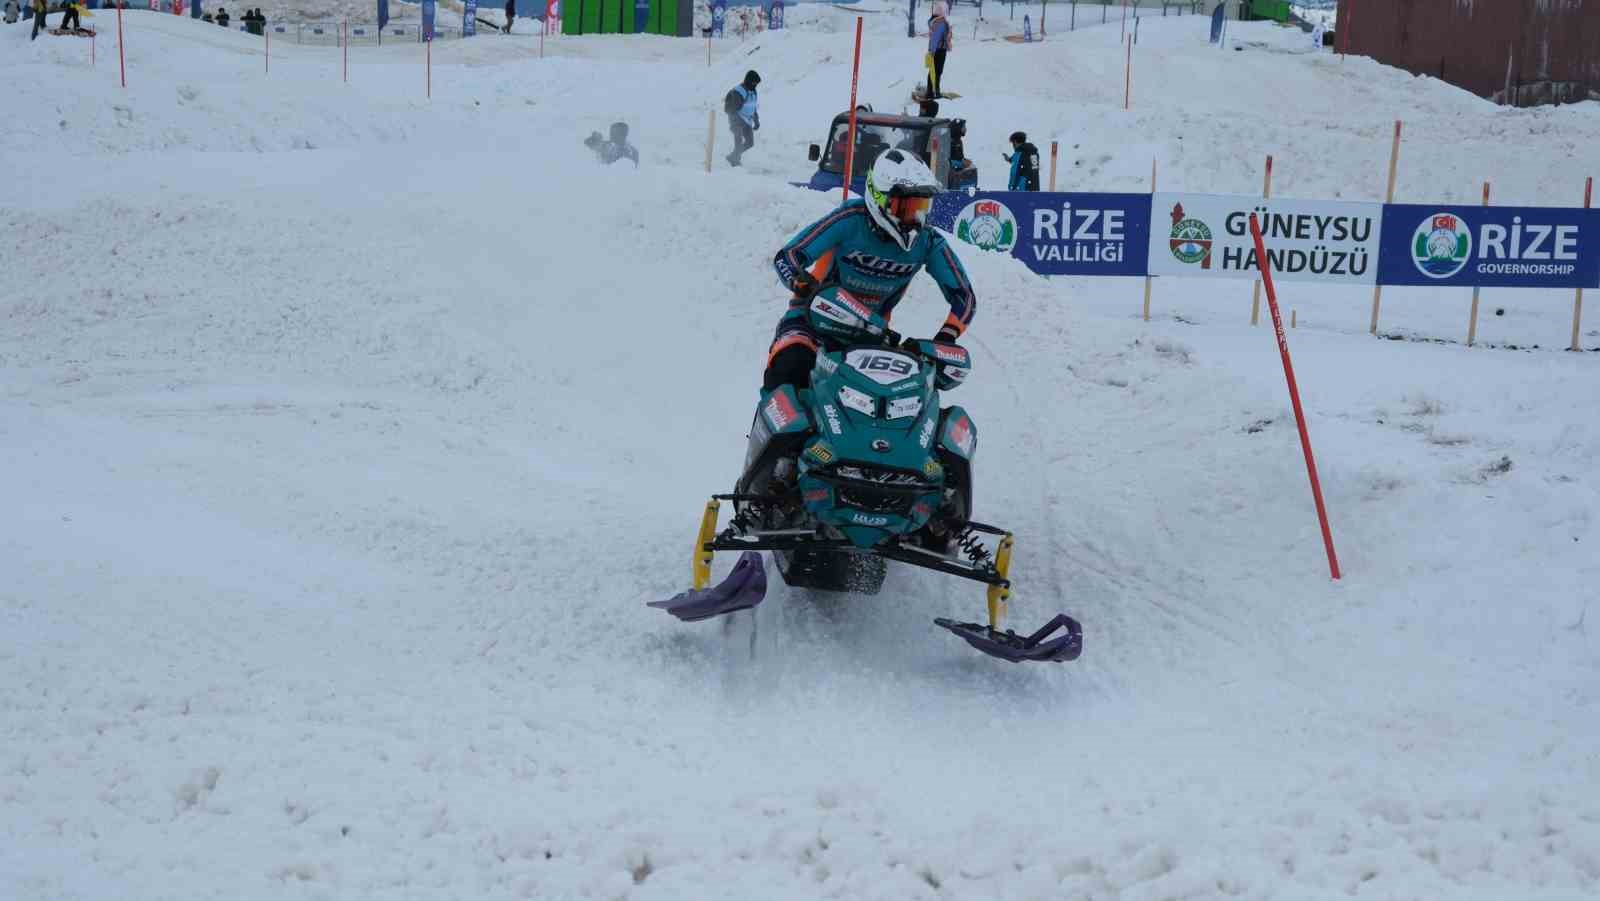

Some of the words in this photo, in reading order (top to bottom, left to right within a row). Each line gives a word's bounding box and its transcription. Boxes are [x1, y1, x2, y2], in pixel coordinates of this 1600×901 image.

[1033, 202, 1125, 240] RİZE
[1225, 206, 1372, 242] GÜNEYSU
[1033, 242, 1124, 262] VALİLİĞİ
[1478, 216, 1579, 260] RİZE
[1222, 246, 1368, 276] HANDÜZÜ
[1477, 263, 1575, 275] GOVERNORSHIP
[858, 355, 914, 375] 169
